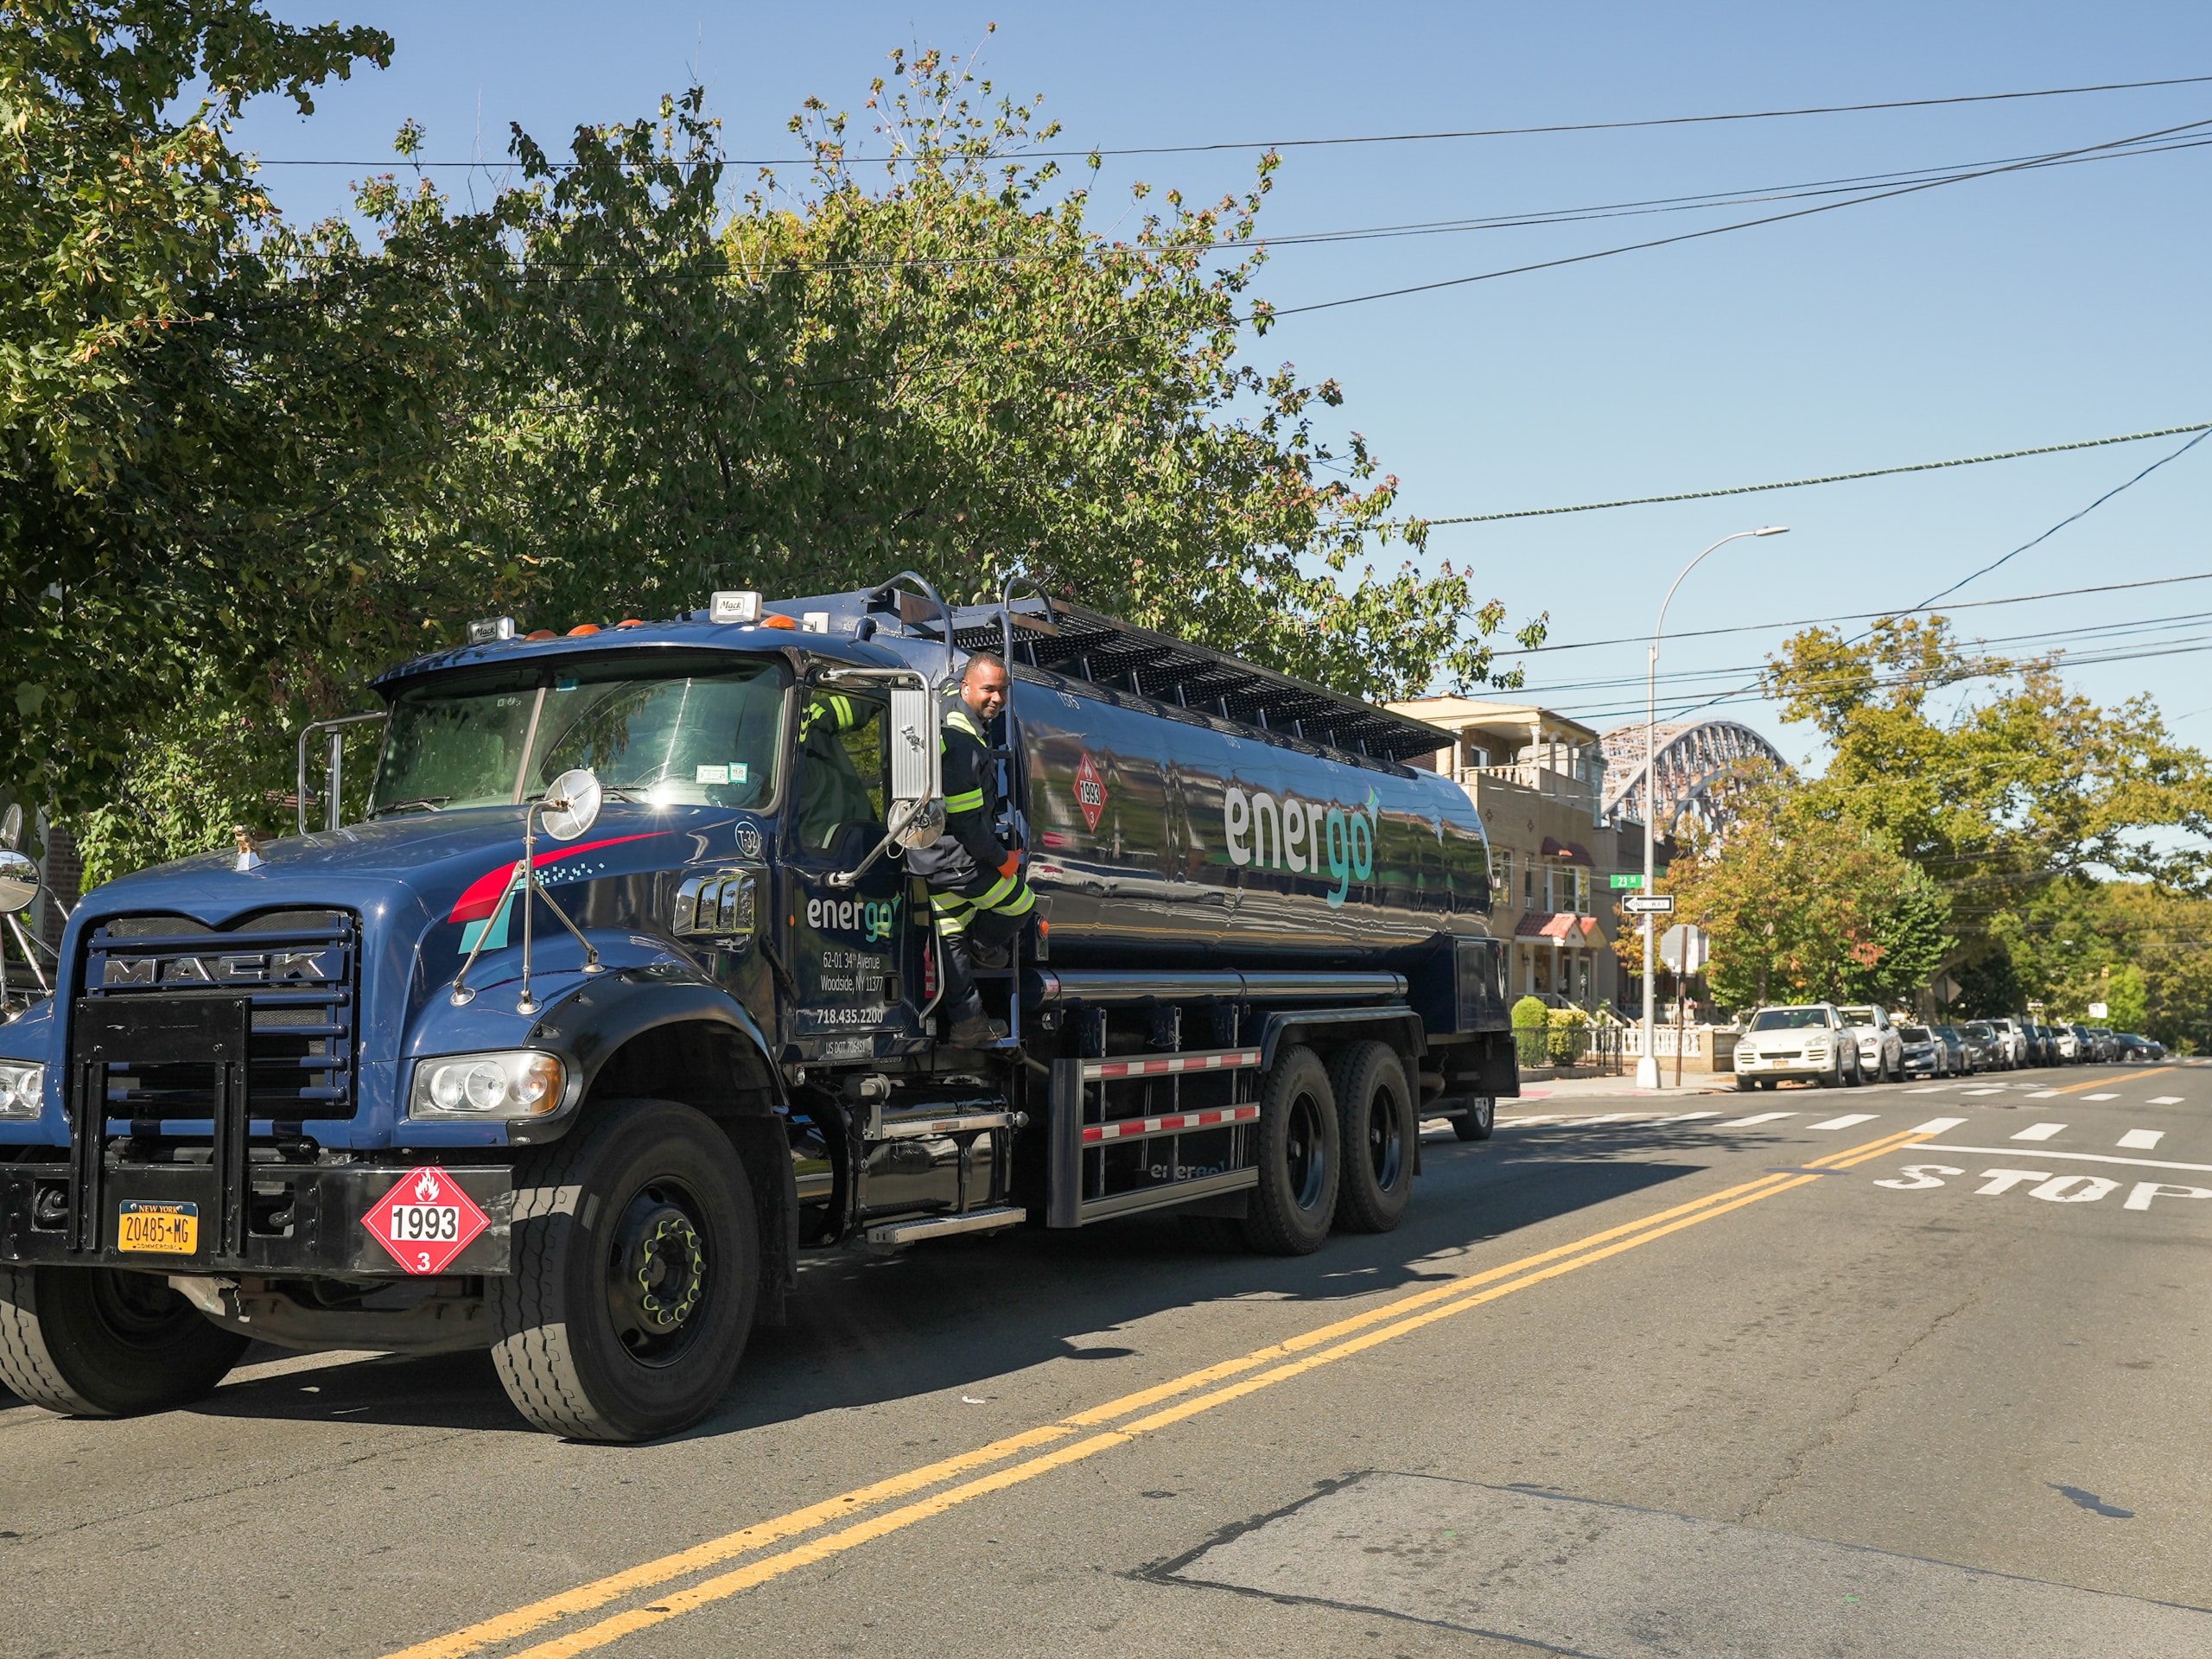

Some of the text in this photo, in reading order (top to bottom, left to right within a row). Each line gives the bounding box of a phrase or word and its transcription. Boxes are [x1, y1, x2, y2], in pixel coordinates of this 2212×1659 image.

[720, 597, 742, 610] Mack
[475, 626, 495, 636] Mack
[1080, 783, 1100, 804] 1993
[1090, 811, 1095, 823] 3
[738, 830, 757, 849] T-32
[1224, 787, 1372, 909] energo
[1618, 876, 1627, 887] 23
[807, 899, 893, 943] energo
[103, 951, 327, 984] MACK
[823, 951, 842, 969] 62-01
[856, 953, 880, 969] Avenue
[820, 974, 883, 995] Woodside, NY 11377
[817, 1009, 883, 1024] 718.435.2200
[825, 1042, 834, 1054] US
[835, 1041, 846, 1054] DOT
[1873, 1164, 2212, 1211] STOP
[138, 1205, 179, 1214] NEW YORK
[393, 1207, 457, 1240] 1993
[416, 1252, 431, 1271] 3
